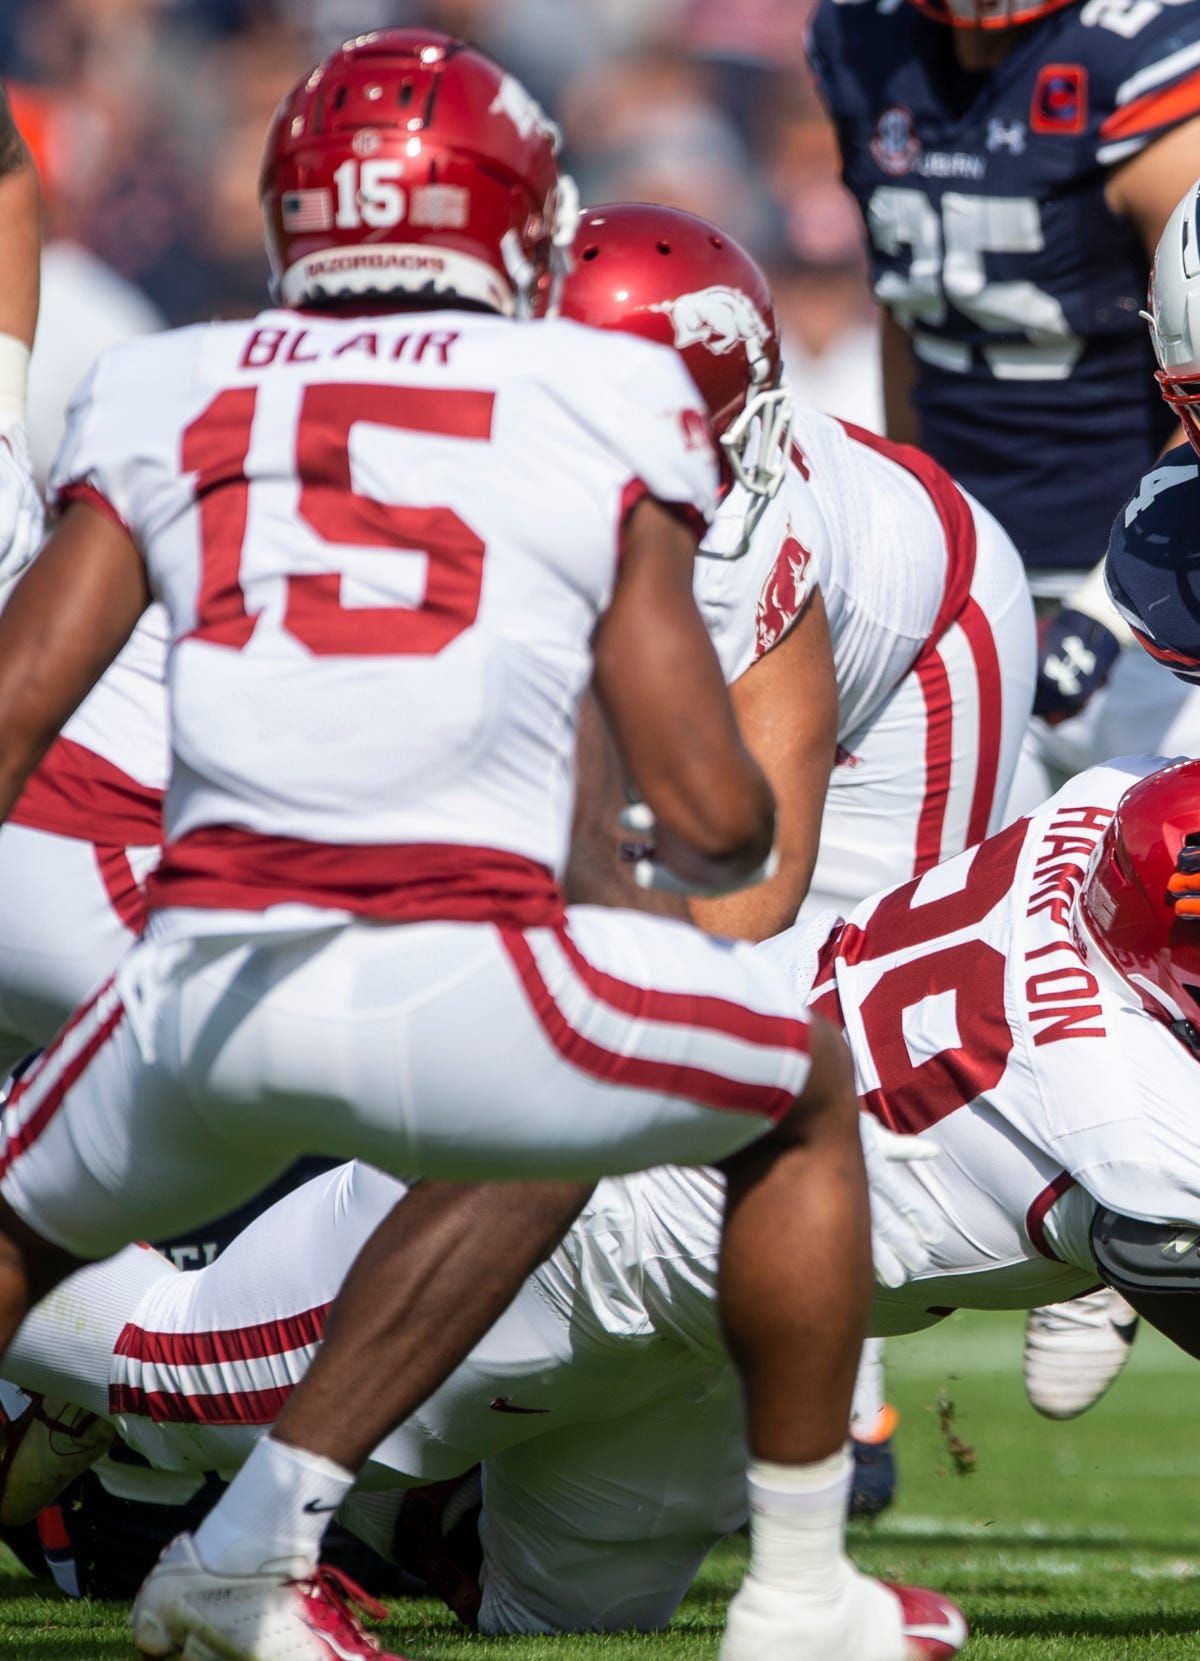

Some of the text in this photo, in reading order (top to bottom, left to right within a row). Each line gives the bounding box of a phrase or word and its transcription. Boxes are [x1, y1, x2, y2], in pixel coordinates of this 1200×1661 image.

[333, 158, 406, 229] 15
[867, 184, 1087, 381] 25
[239, 328, 461, 370] BLAIR
[180, 381, 497, 658] 15
[1124, 464, 1199, 529] 4
